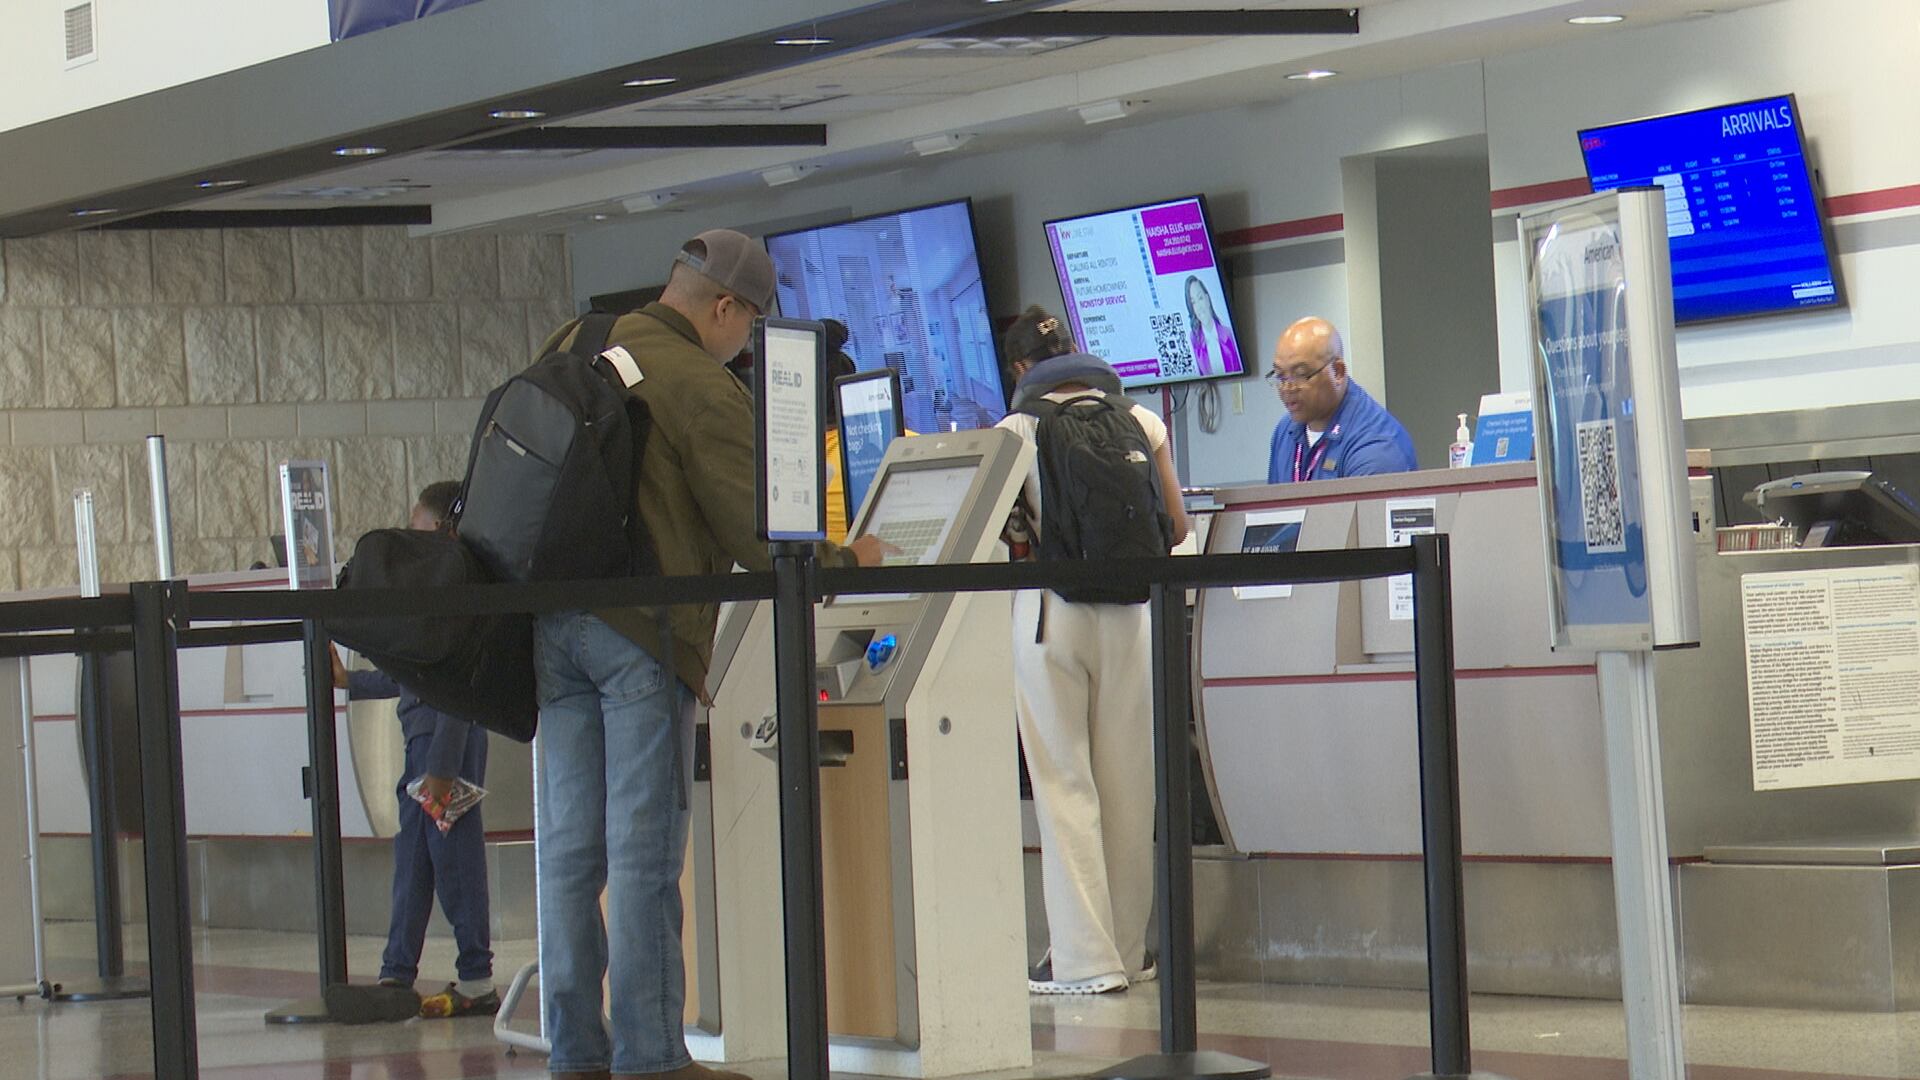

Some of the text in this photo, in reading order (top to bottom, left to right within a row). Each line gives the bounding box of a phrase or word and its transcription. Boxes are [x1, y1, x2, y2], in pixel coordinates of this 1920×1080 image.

[1721, 106, 1792, 138] ARRIVALS
[1584, 245, 1615, 264] American
[1070, 261, 1090, 273] CALLING
[1079, 294, 1127, 309] NONSTOP SERVICE
[1098, 323, 1115, 335] CLASS
[1546, 336, 1577, 354] Questions
[1579, 330, 1598, 349] about
[1599, 331, 1614, 352] your
[848, 438, 864, 454] bags?
